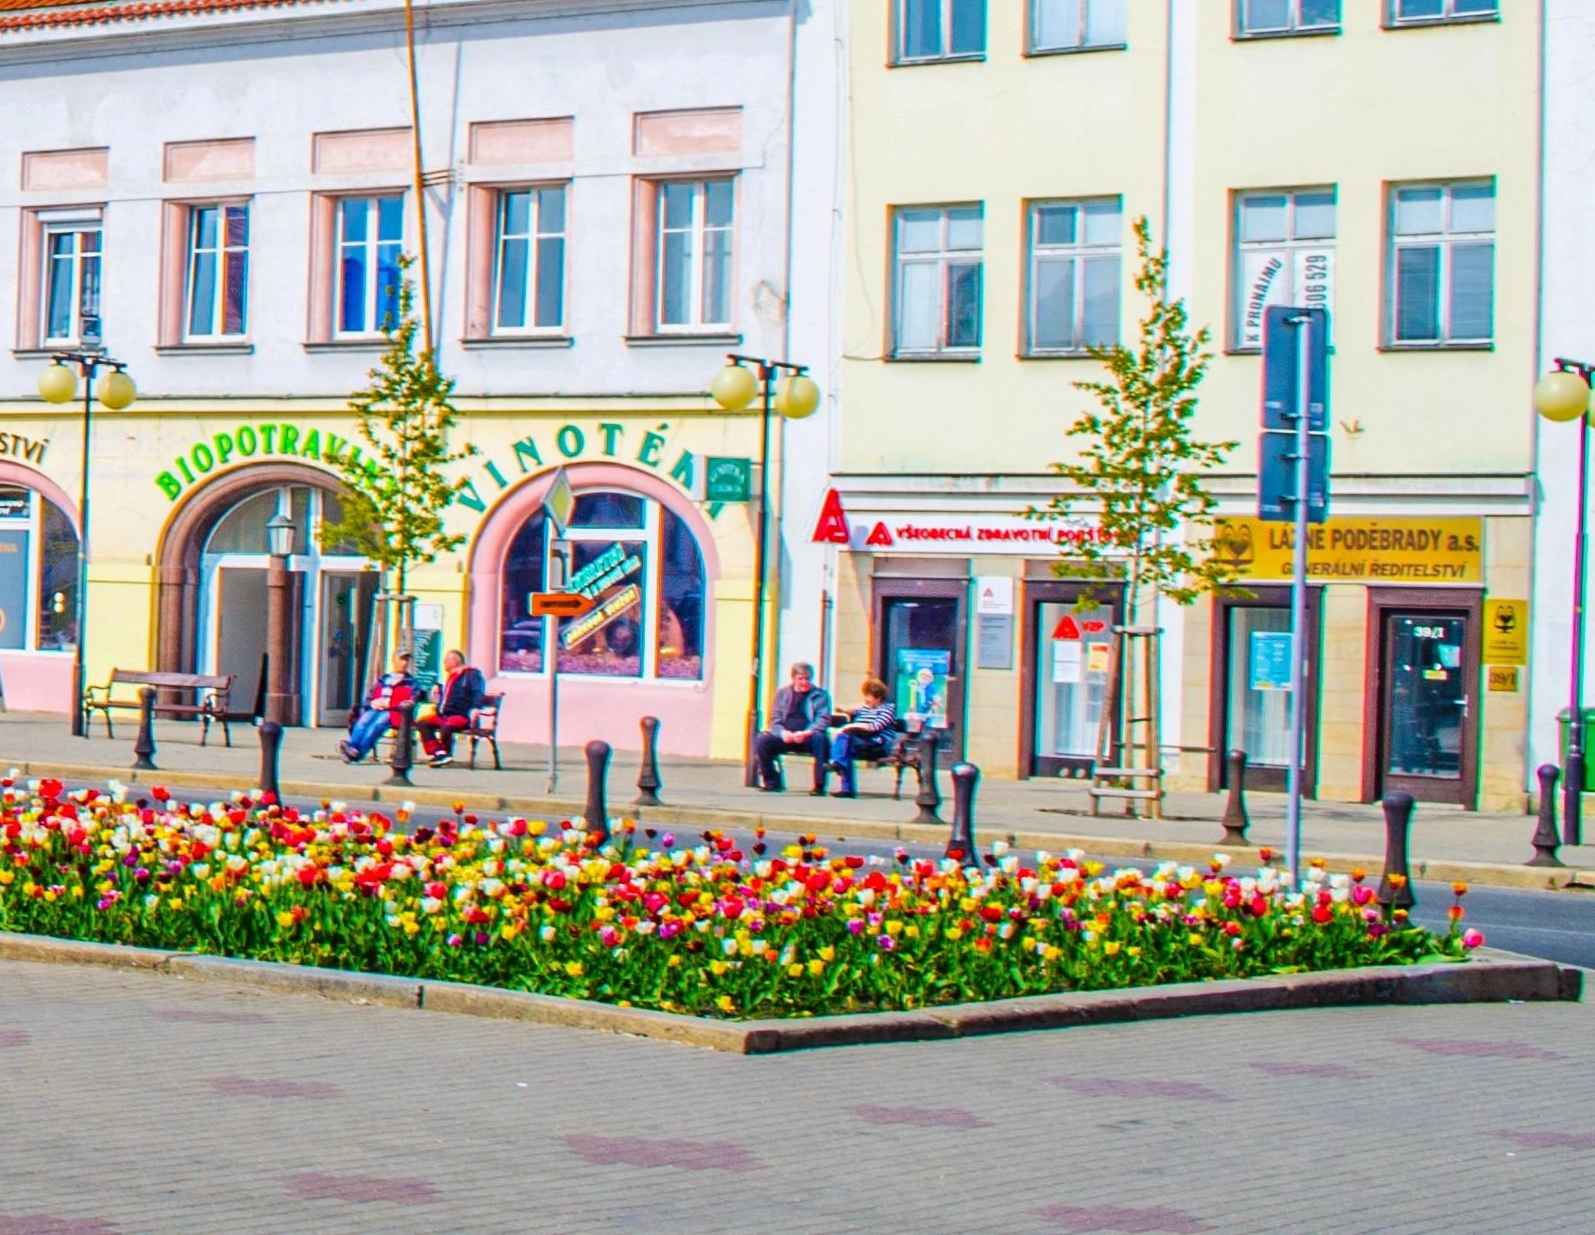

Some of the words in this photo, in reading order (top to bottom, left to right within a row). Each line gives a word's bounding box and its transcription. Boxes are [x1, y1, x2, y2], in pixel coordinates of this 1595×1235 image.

[1305, 255, 1328, 281] 529
[896, 524, 971, 540] VŠEOBECNÁ
[977, 526, 1052, 542] ZDRAVOTNÍ
[1332, 522, 1442, 551] PODĚBRADY
[1448, 534, 1480, 553] a.s.
[1371, 561, 1467, 578] ŘEDITELSTVÍ
